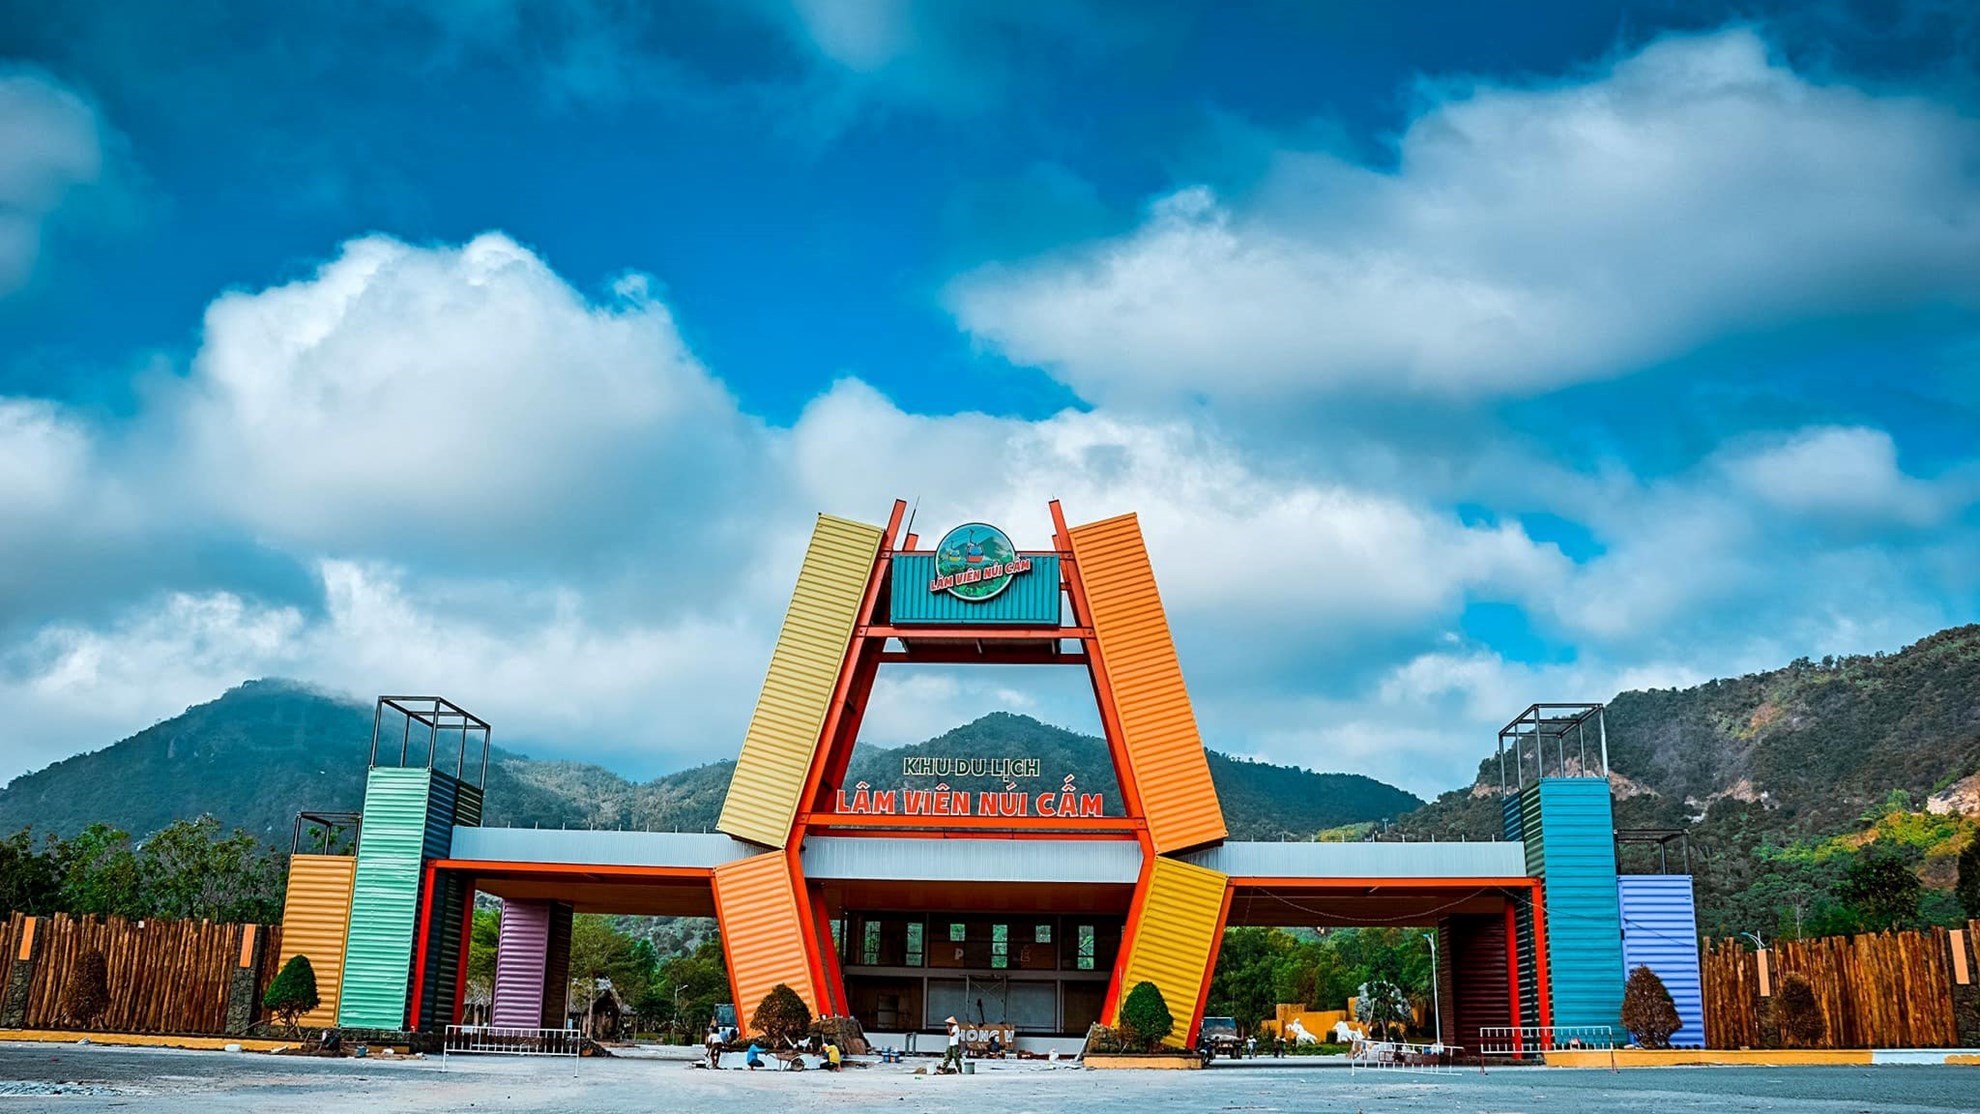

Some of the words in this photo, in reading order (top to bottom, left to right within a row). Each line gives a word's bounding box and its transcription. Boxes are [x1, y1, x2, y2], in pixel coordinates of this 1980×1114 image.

[930, 574, 953, 591] LÂM
[956, 567, 981, 585] VIÊN
[983, 562, 1003, 580] NÚI
[903, 758, 950, 776] KHU
[955, 758, 985, 776] DU
[991, 758, 1040, 782] LỊCH
[835, 780, 896, 814] LÂM
[903, 782, 971, 815] VIÊN
[979, 783, 1028, 817] NÚI
[1035, 773, 1103, 817] CẤM
